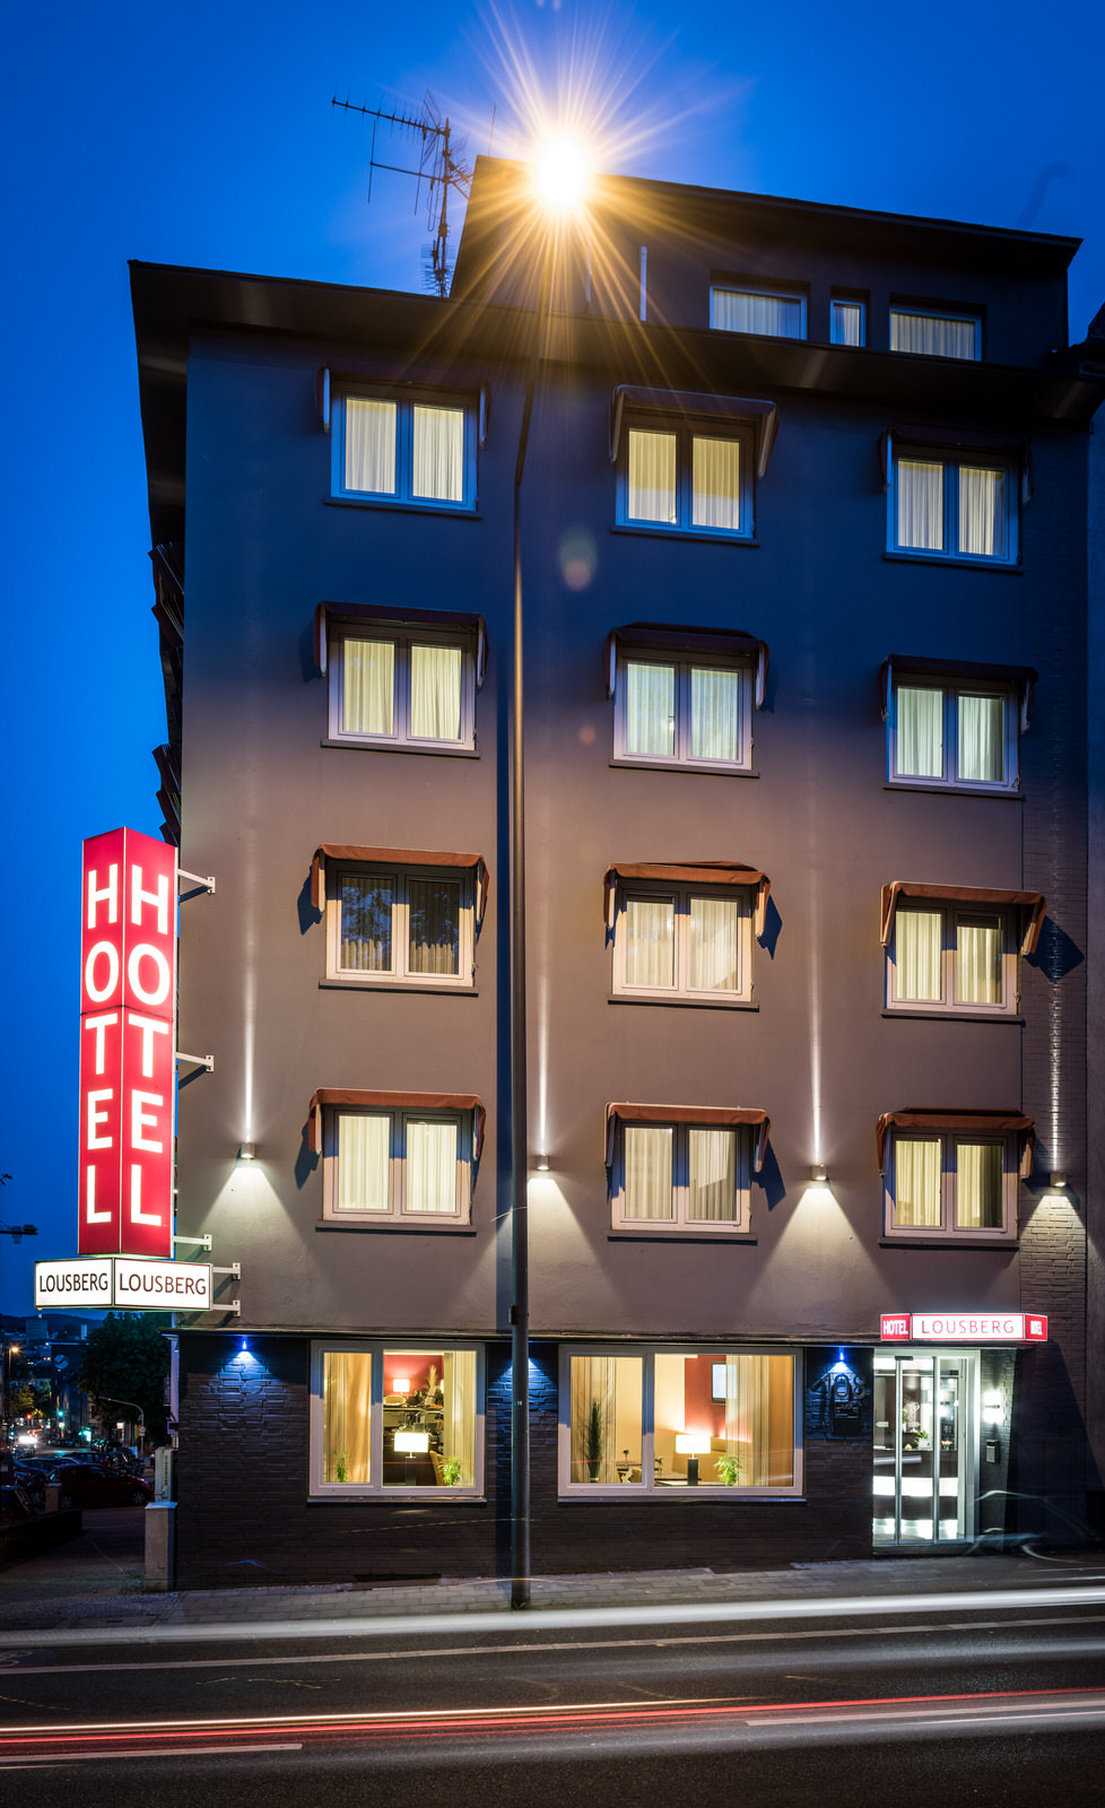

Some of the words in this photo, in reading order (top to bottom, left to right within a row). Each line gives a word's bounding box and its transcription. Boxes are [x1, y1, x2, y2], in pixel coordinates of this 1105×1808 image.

[85, 864, 119, 1224] HOTEL
[128, 864, 170, 1226] HOTEL
[39, 1273, 109, 1293] LOUSBERG
[119, 1273, 206, 1296] LOUSBERG
[882, 1319, 908, 1336] HOTEL
[921, 1320, 1015, 1334] LOUSBERG
